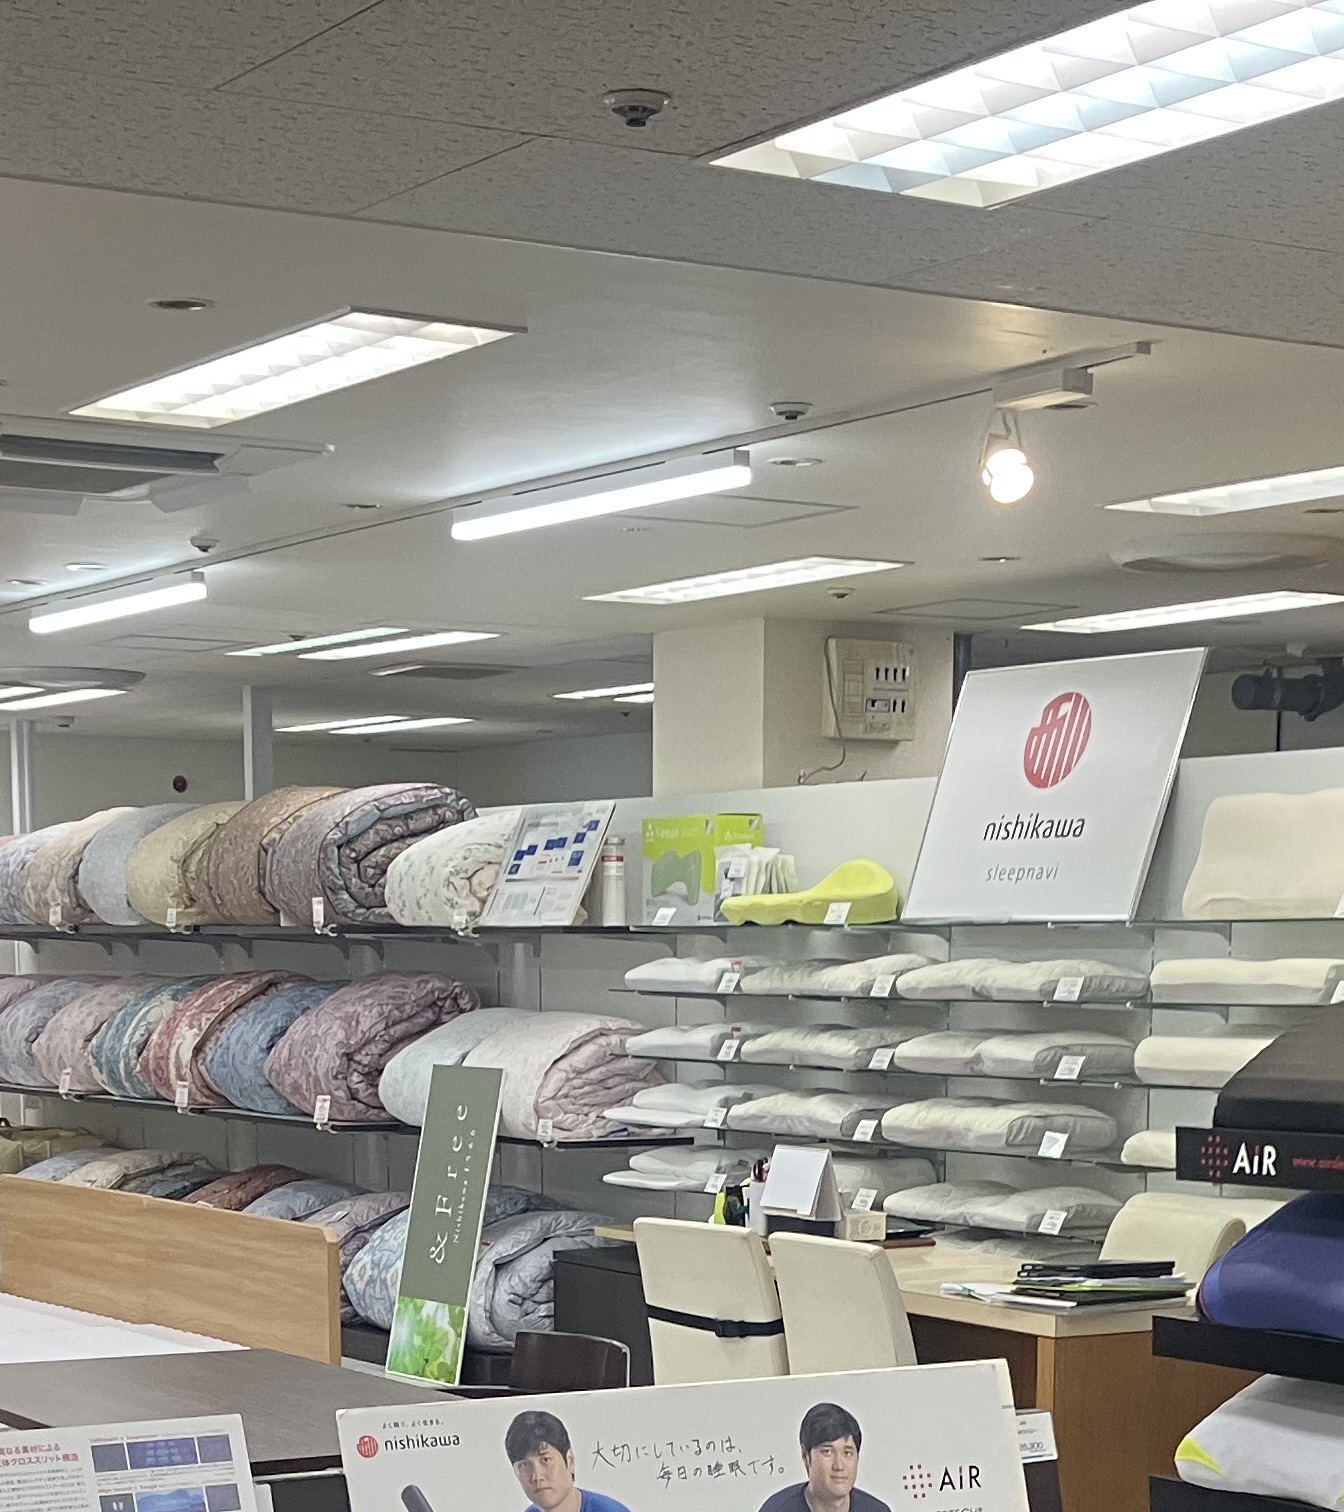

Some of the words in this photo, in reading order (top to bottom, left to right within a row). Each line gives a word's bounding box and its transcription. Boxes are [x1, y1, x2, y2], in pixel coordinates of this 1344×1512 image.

[982, 811, 1086, 841] nishikawa
[985, 862, 1060, 885] sleepnavi
[384, 1433, 461, 1452] nishikawa
[656, 1455, 785, 1489] 毎日の睡眠です。
